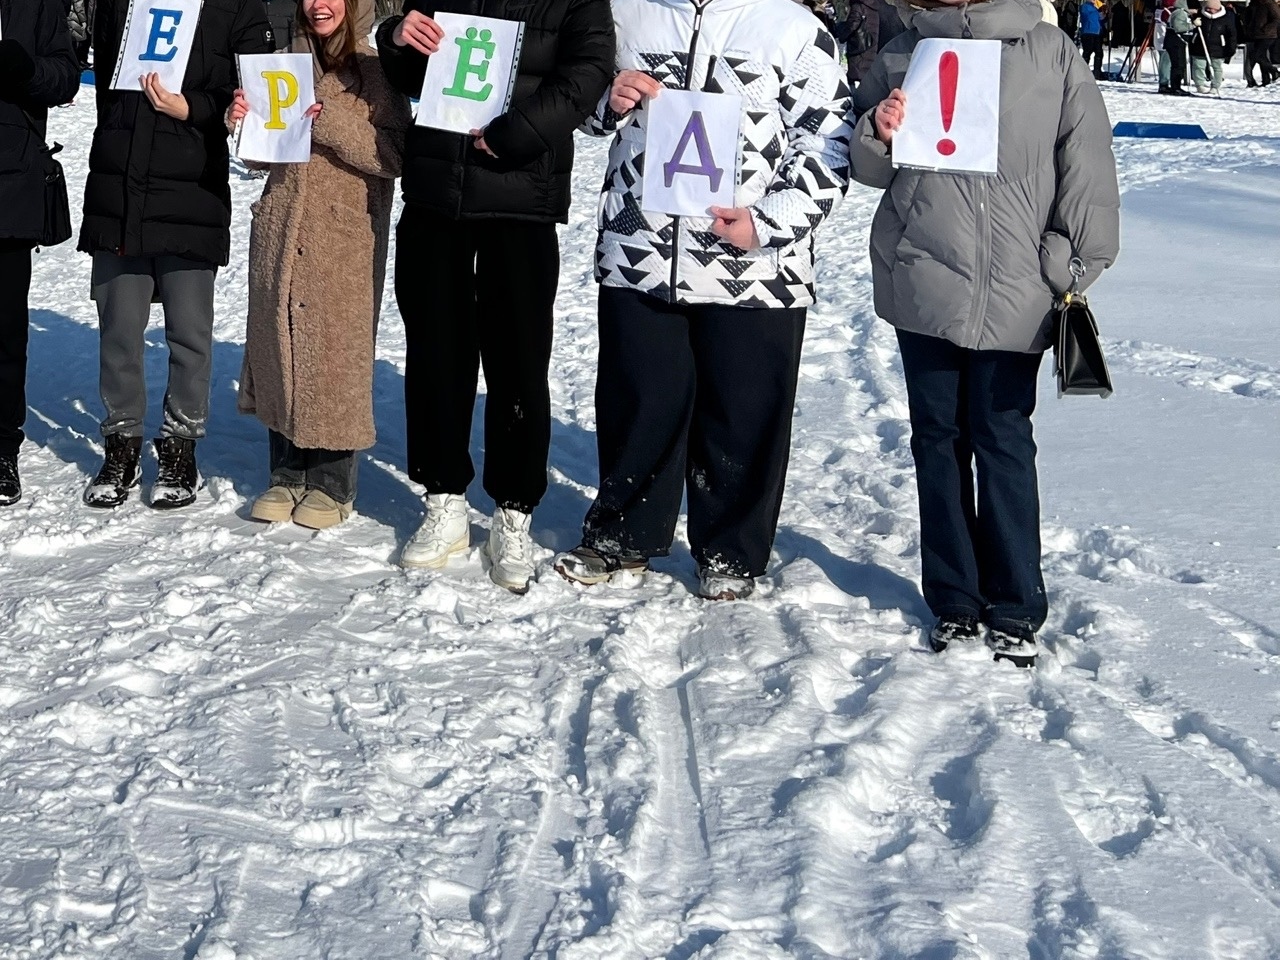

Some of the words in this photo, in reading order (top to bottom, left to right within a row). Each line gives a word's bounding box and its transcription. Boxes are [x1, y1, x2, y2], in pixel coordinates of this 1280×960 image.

[138, 7, 183, 62] Е
[442, 26, 496, 102] Ё
[261, 70, 299, 130] Р
[935, 50, 959, 156] !
[663, 110, 724, 193] Д
